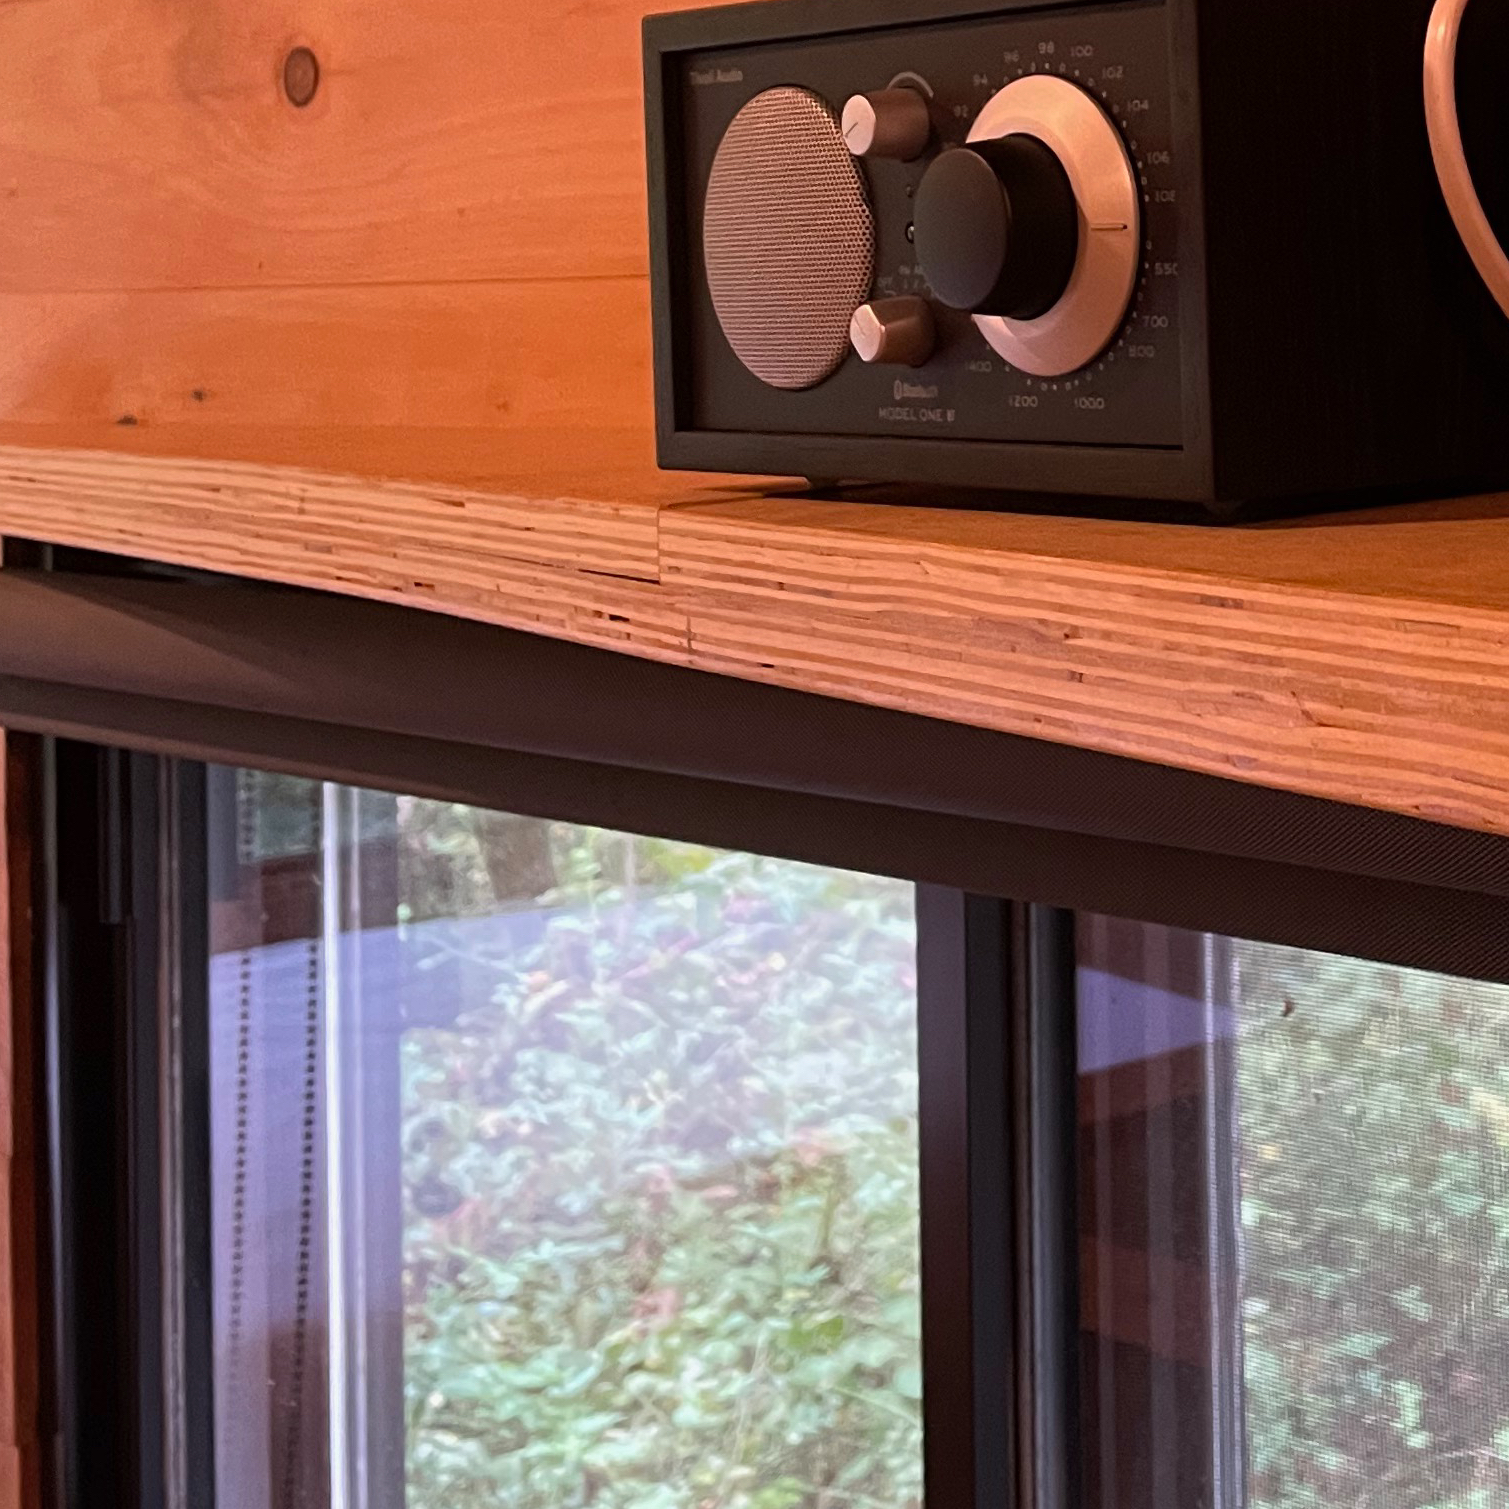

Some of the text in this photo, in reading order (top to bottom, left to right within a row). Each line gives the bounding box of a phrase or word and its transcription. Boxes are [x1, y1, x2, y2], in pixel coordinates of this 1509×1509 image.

[1070, 45, 1093, 57] 100
[1102, 66, 1123, 79] 102
[1127, 99, 1149, 111] 104
[1143, 316, 1168, 328] 700
[878, 407, 917, 421] MODEL
[920, 408, 943, 422] ONE
